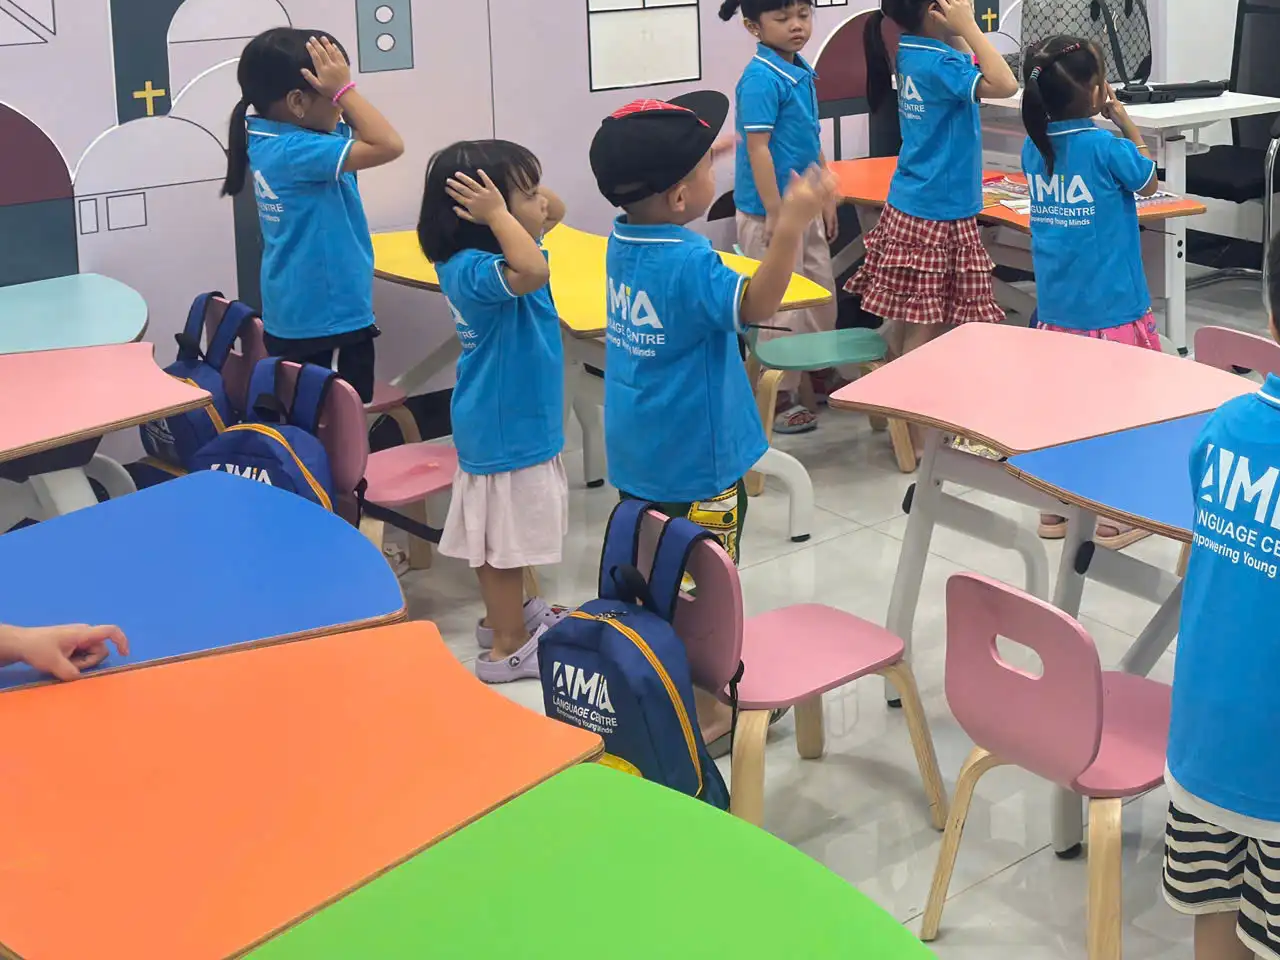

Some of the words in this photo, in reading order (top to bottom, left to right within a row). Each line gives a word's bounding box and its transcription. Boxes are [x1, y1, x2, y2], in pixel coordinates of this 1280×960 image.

[1031, 205, 1059, 215] GUAGE
[1059, 205, 1096, 217] CENTRE
[608, 276, 663, 328] MiA
[1196, 509, 1258, 548] NGUAGE
[1193, 531, 1240, 564] mpowering
[1243, 551, 1277, 579] Young
[552, 695, 590, 719] LANGUAGE
